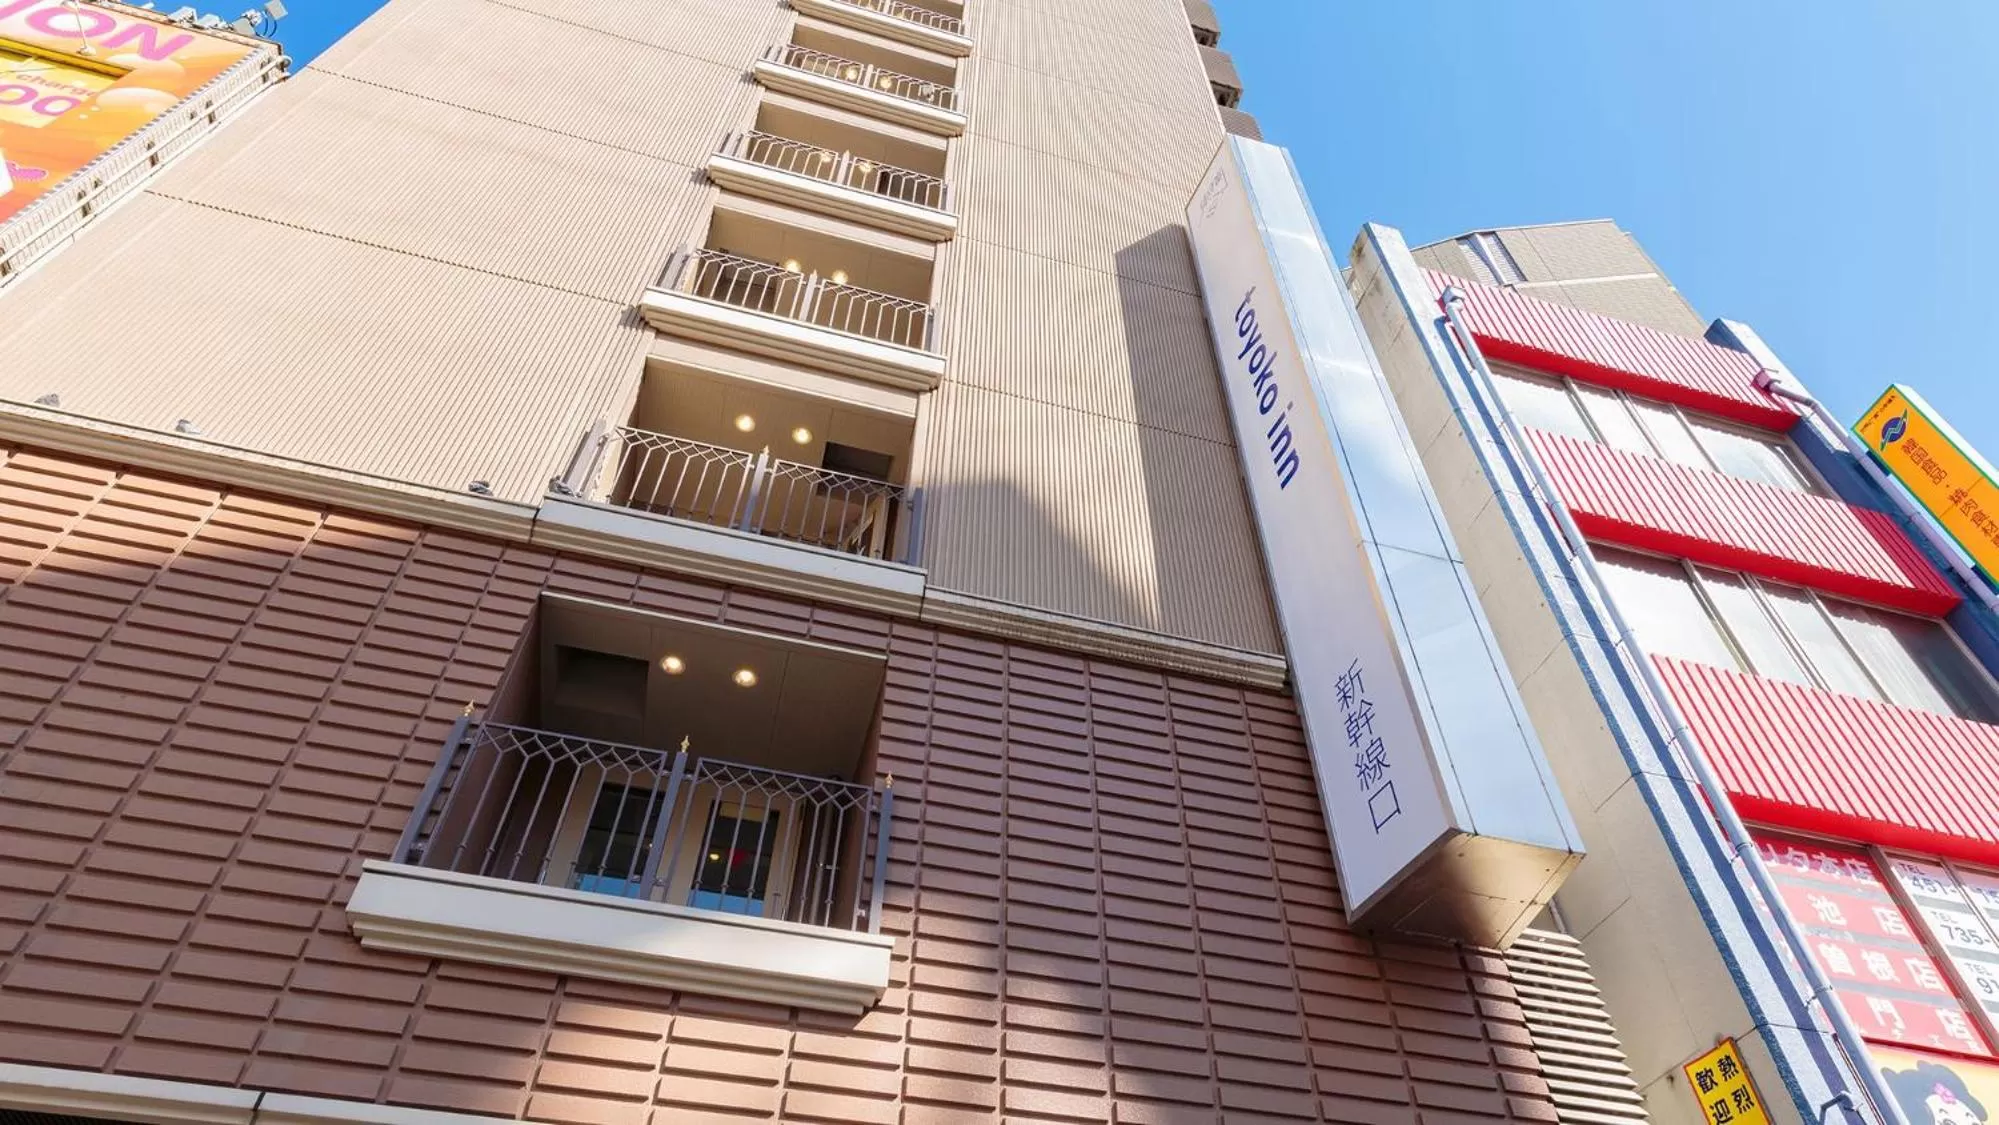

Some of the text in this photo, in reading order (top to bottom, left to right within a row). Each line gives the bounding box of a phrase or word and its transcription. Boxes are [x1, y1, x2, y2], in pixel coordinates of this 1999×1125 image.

[1235, 285, 1301, 490] toyoko inn
[1334, 657, 1402, 834] 新幹線口
[1898, 862, 1925, 875] TEL
